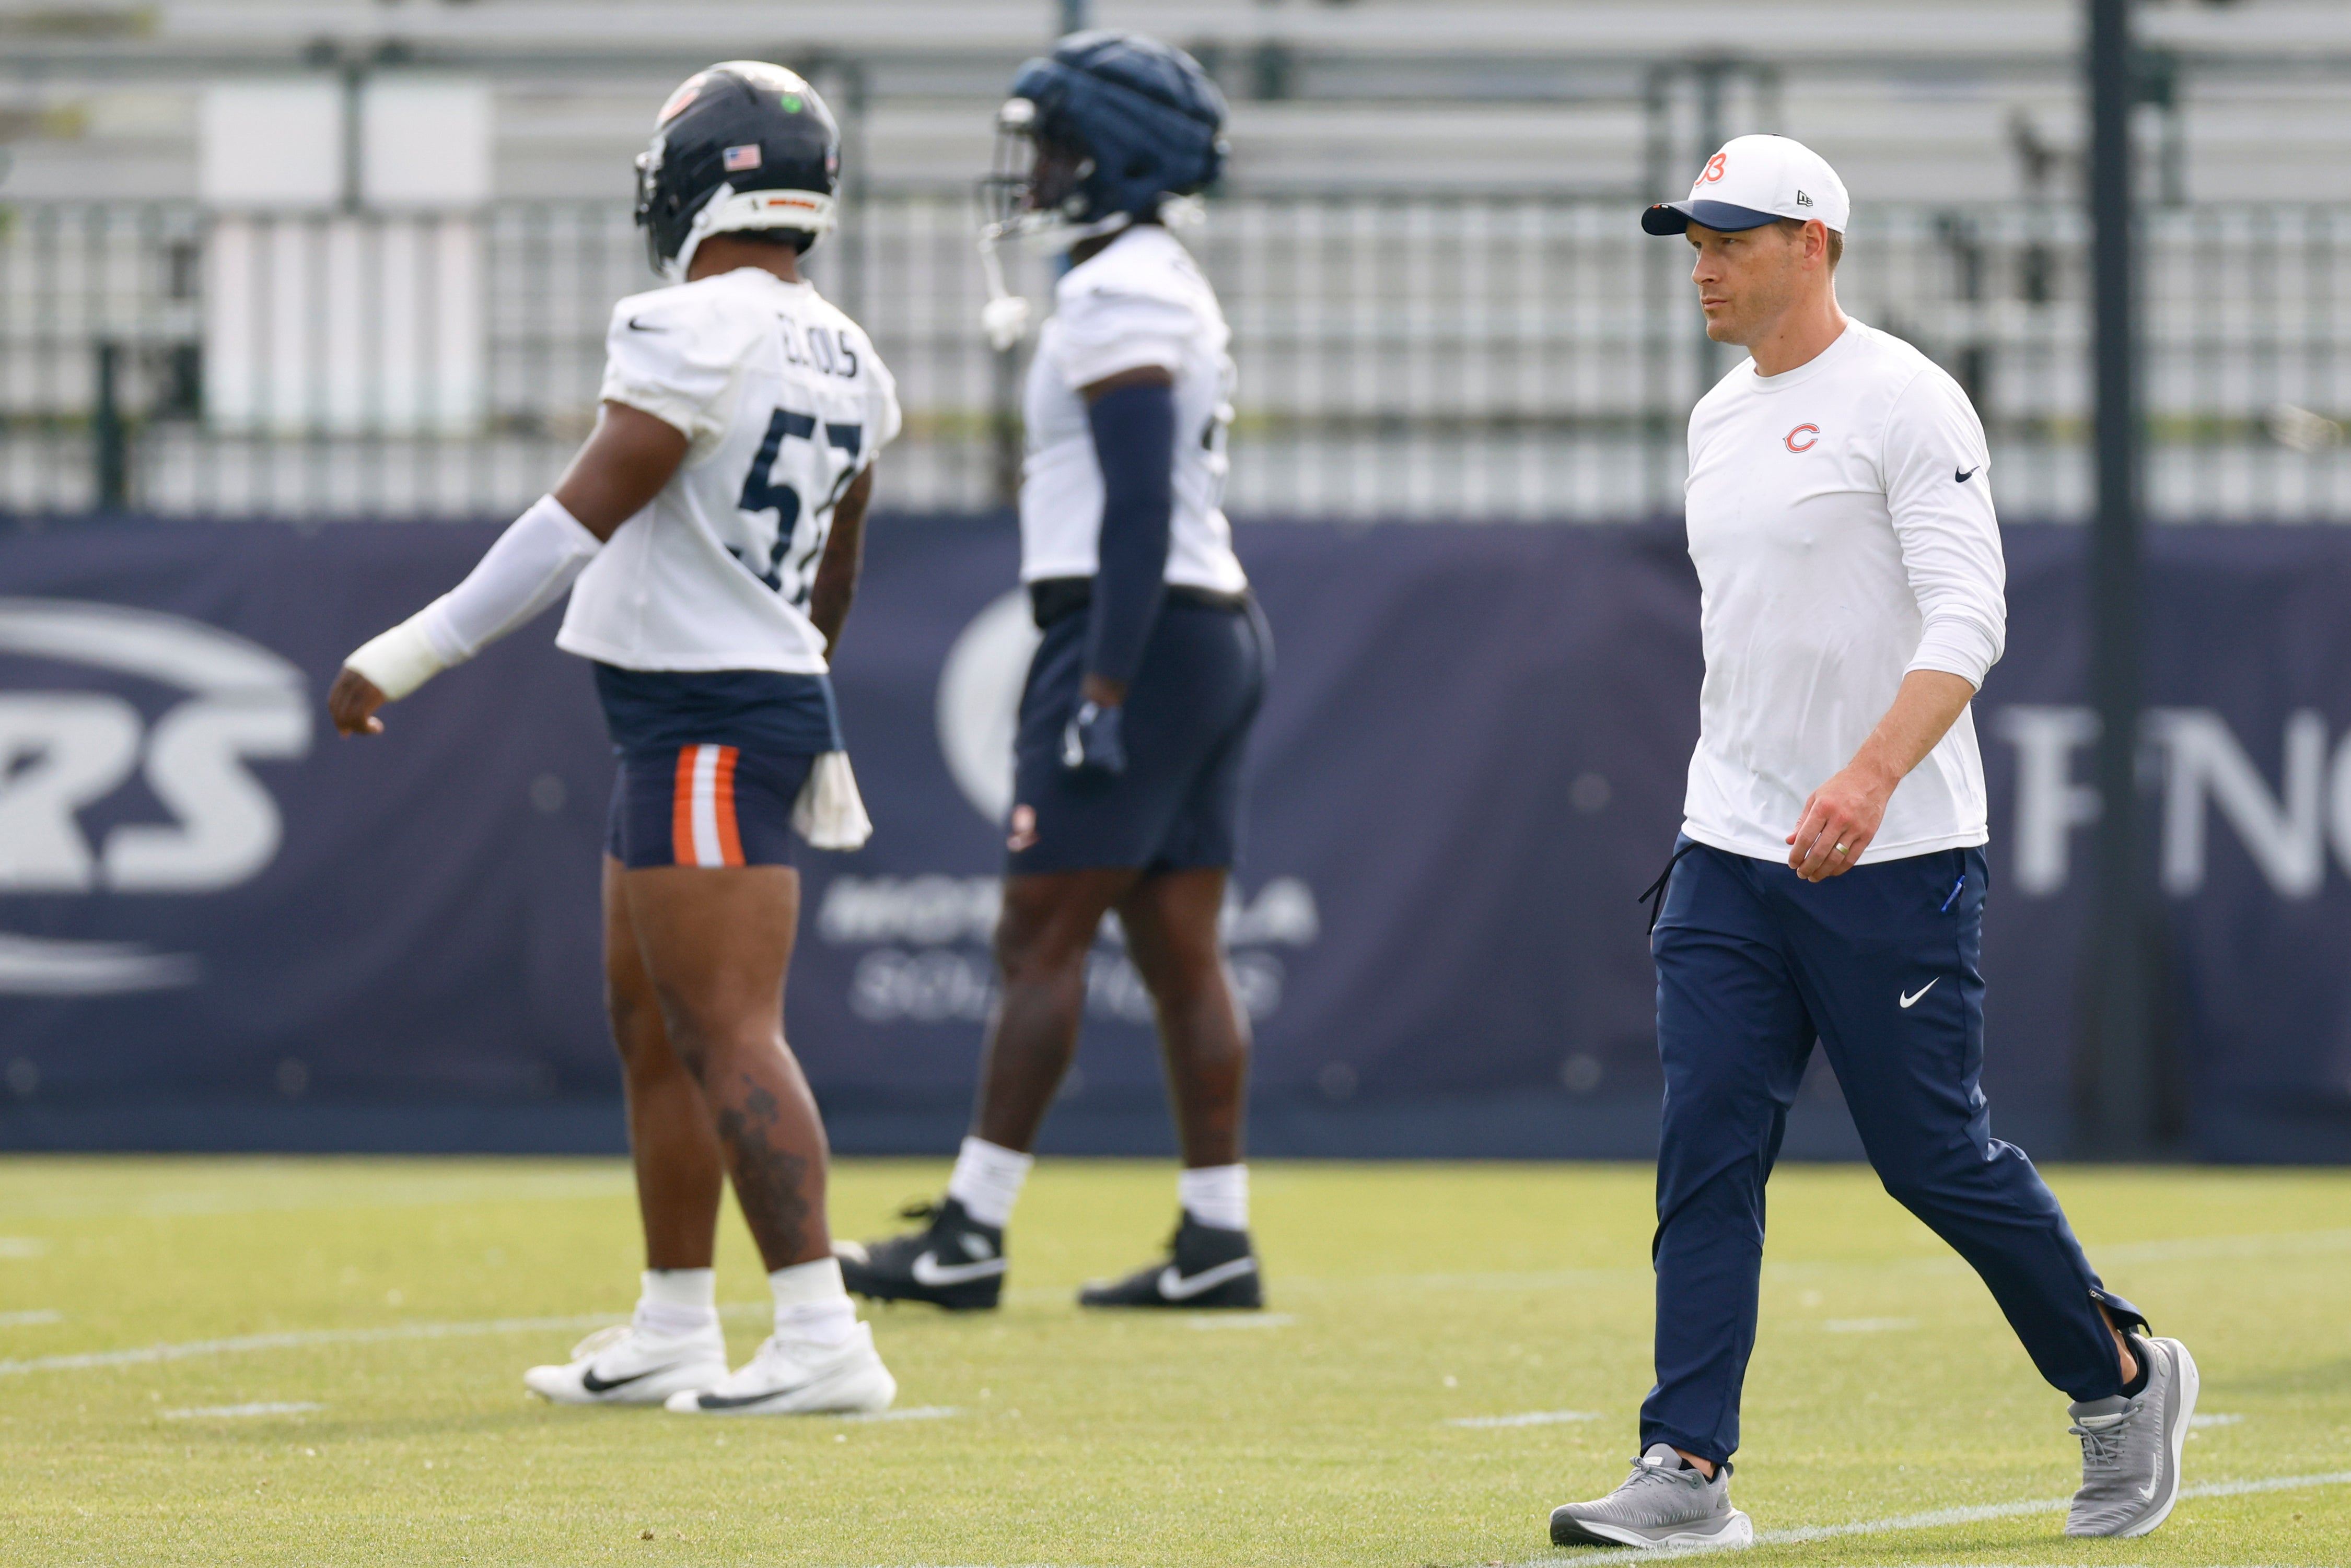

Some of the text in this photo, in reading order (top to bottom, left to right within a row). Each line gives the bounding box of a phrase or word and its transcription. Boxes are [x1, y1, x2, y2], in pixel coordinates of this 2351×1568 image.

[1695, 153, 1726, 185] B
[1783, 423, 1820, 453] C
[1995, 706, 2351, 893] PN
